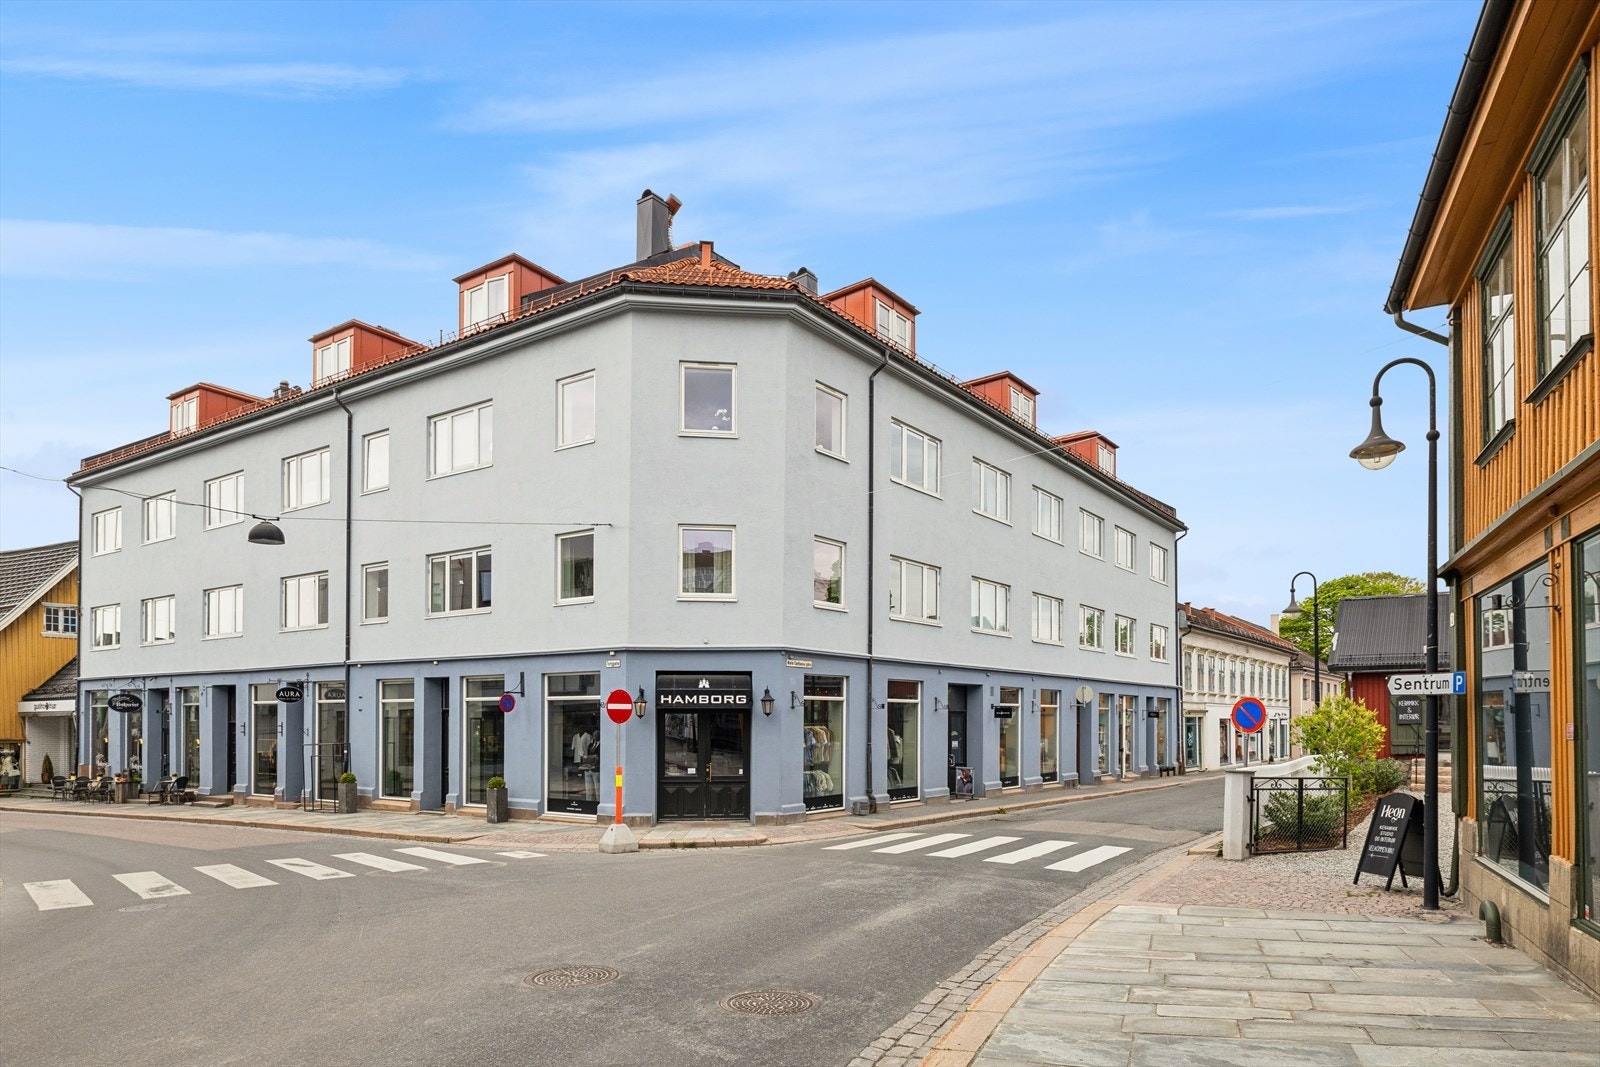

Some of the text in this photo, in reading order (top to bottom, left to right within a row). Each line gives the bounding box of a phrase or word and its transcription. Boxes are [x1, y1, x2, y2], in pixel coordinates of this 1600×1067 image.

[1394, 675, 1463, 692] Sentrum P
[660, 694, 747, 704] HAMBORG
[1380, 804, 1406, 824] Hegn
